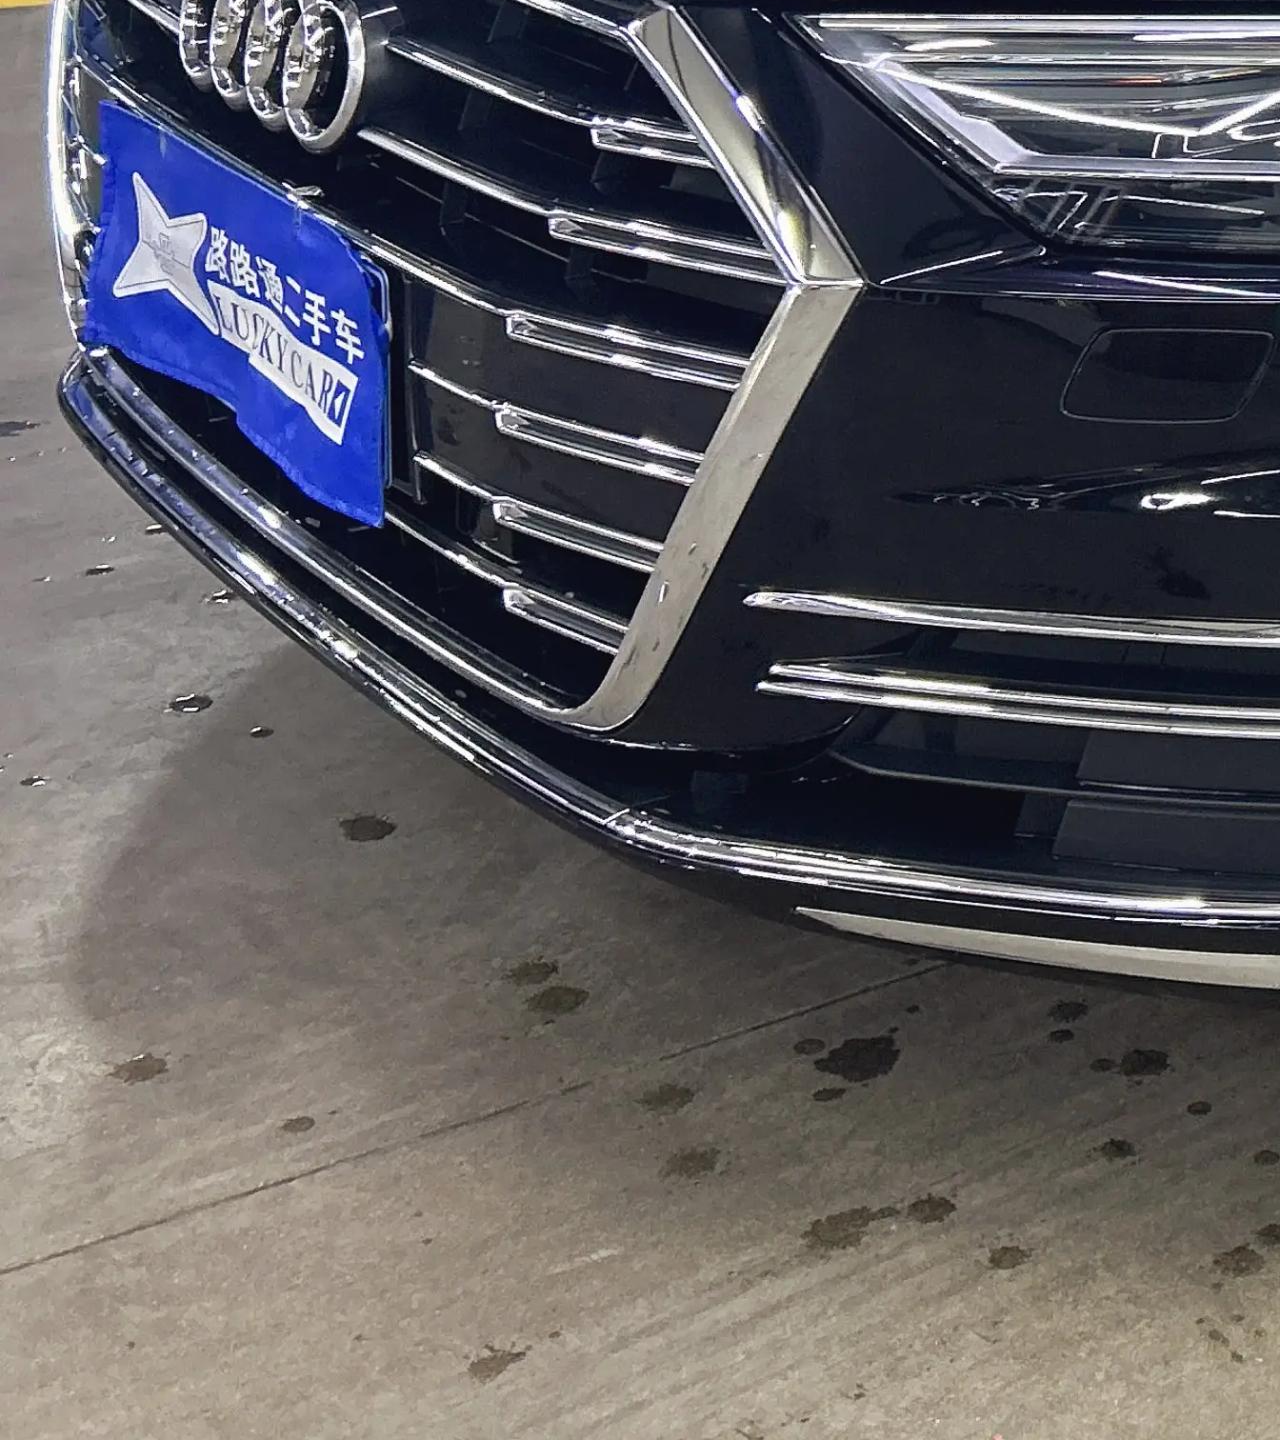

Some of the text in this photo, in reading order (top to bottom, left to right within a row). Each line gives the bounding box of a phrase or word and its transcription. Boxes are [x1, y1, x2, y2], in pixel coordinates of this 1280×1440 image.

[205, 227, 364, 364] 路路通二手车
